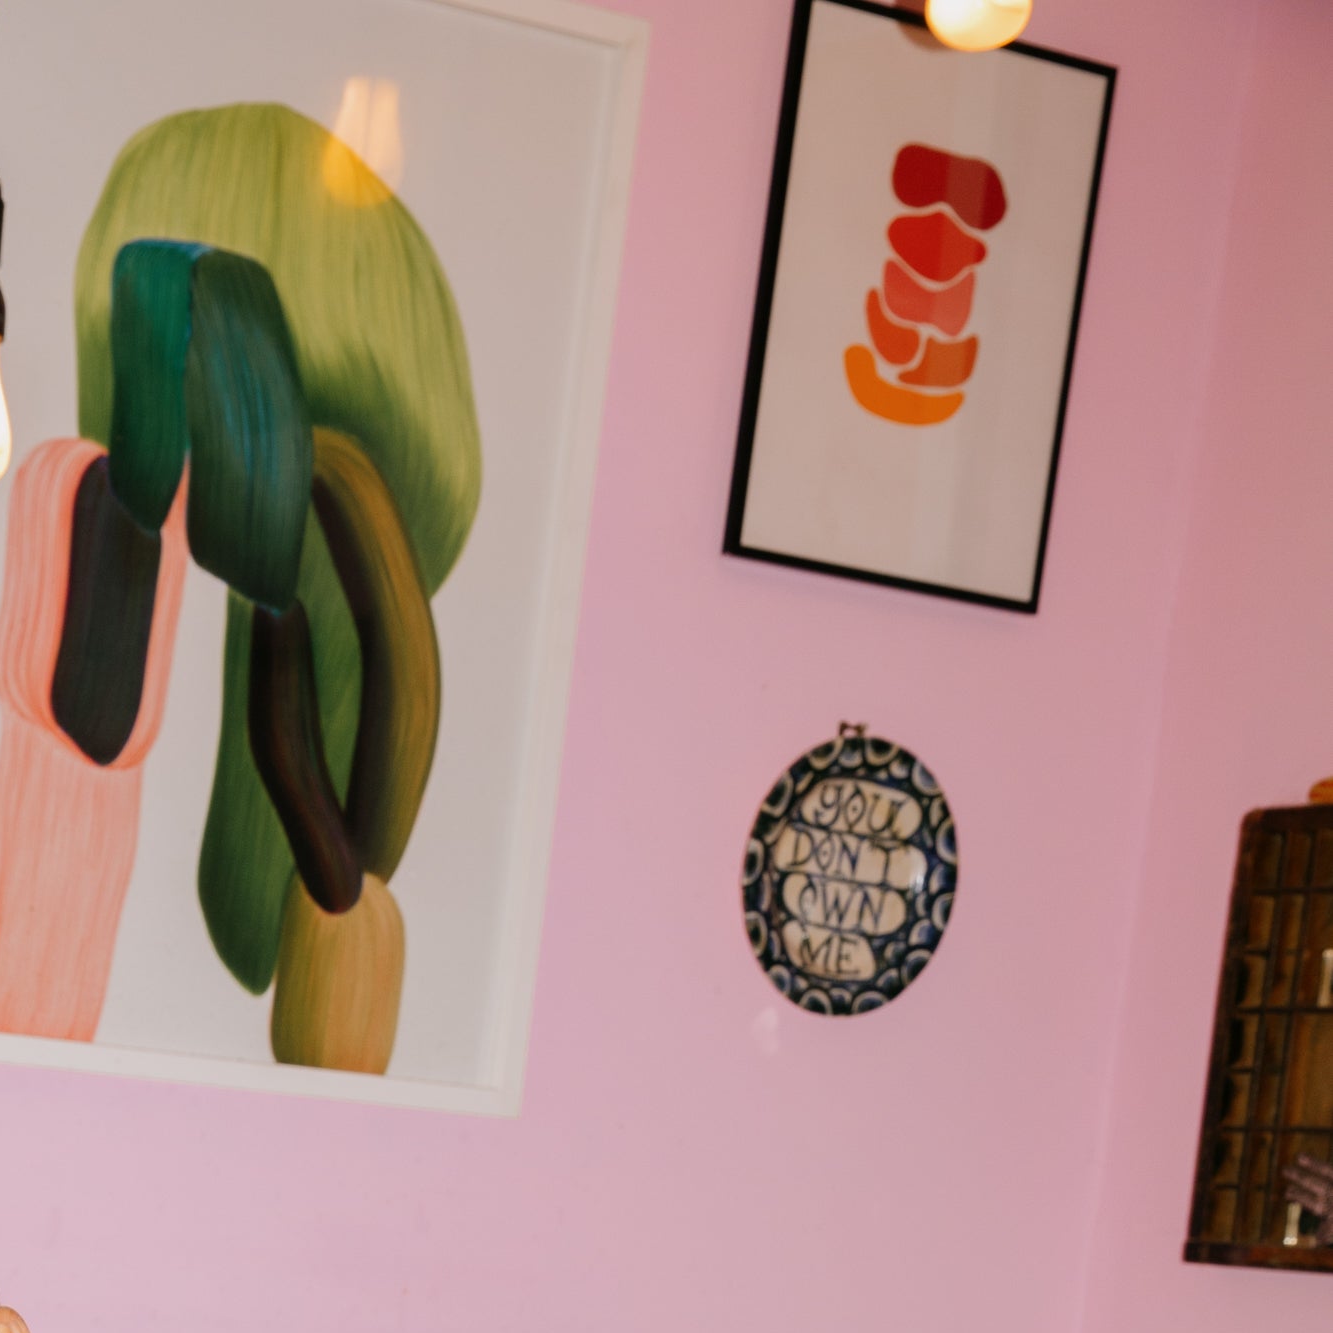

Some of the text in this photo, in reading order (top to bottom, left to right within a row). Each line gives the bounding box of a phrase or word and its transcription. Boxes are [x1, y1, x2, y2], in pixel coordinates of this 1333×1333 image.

[814, 784, 906, 834] YOU
[798, 877, 886, 932] OWN
[800, 934, 861, 975] ME
